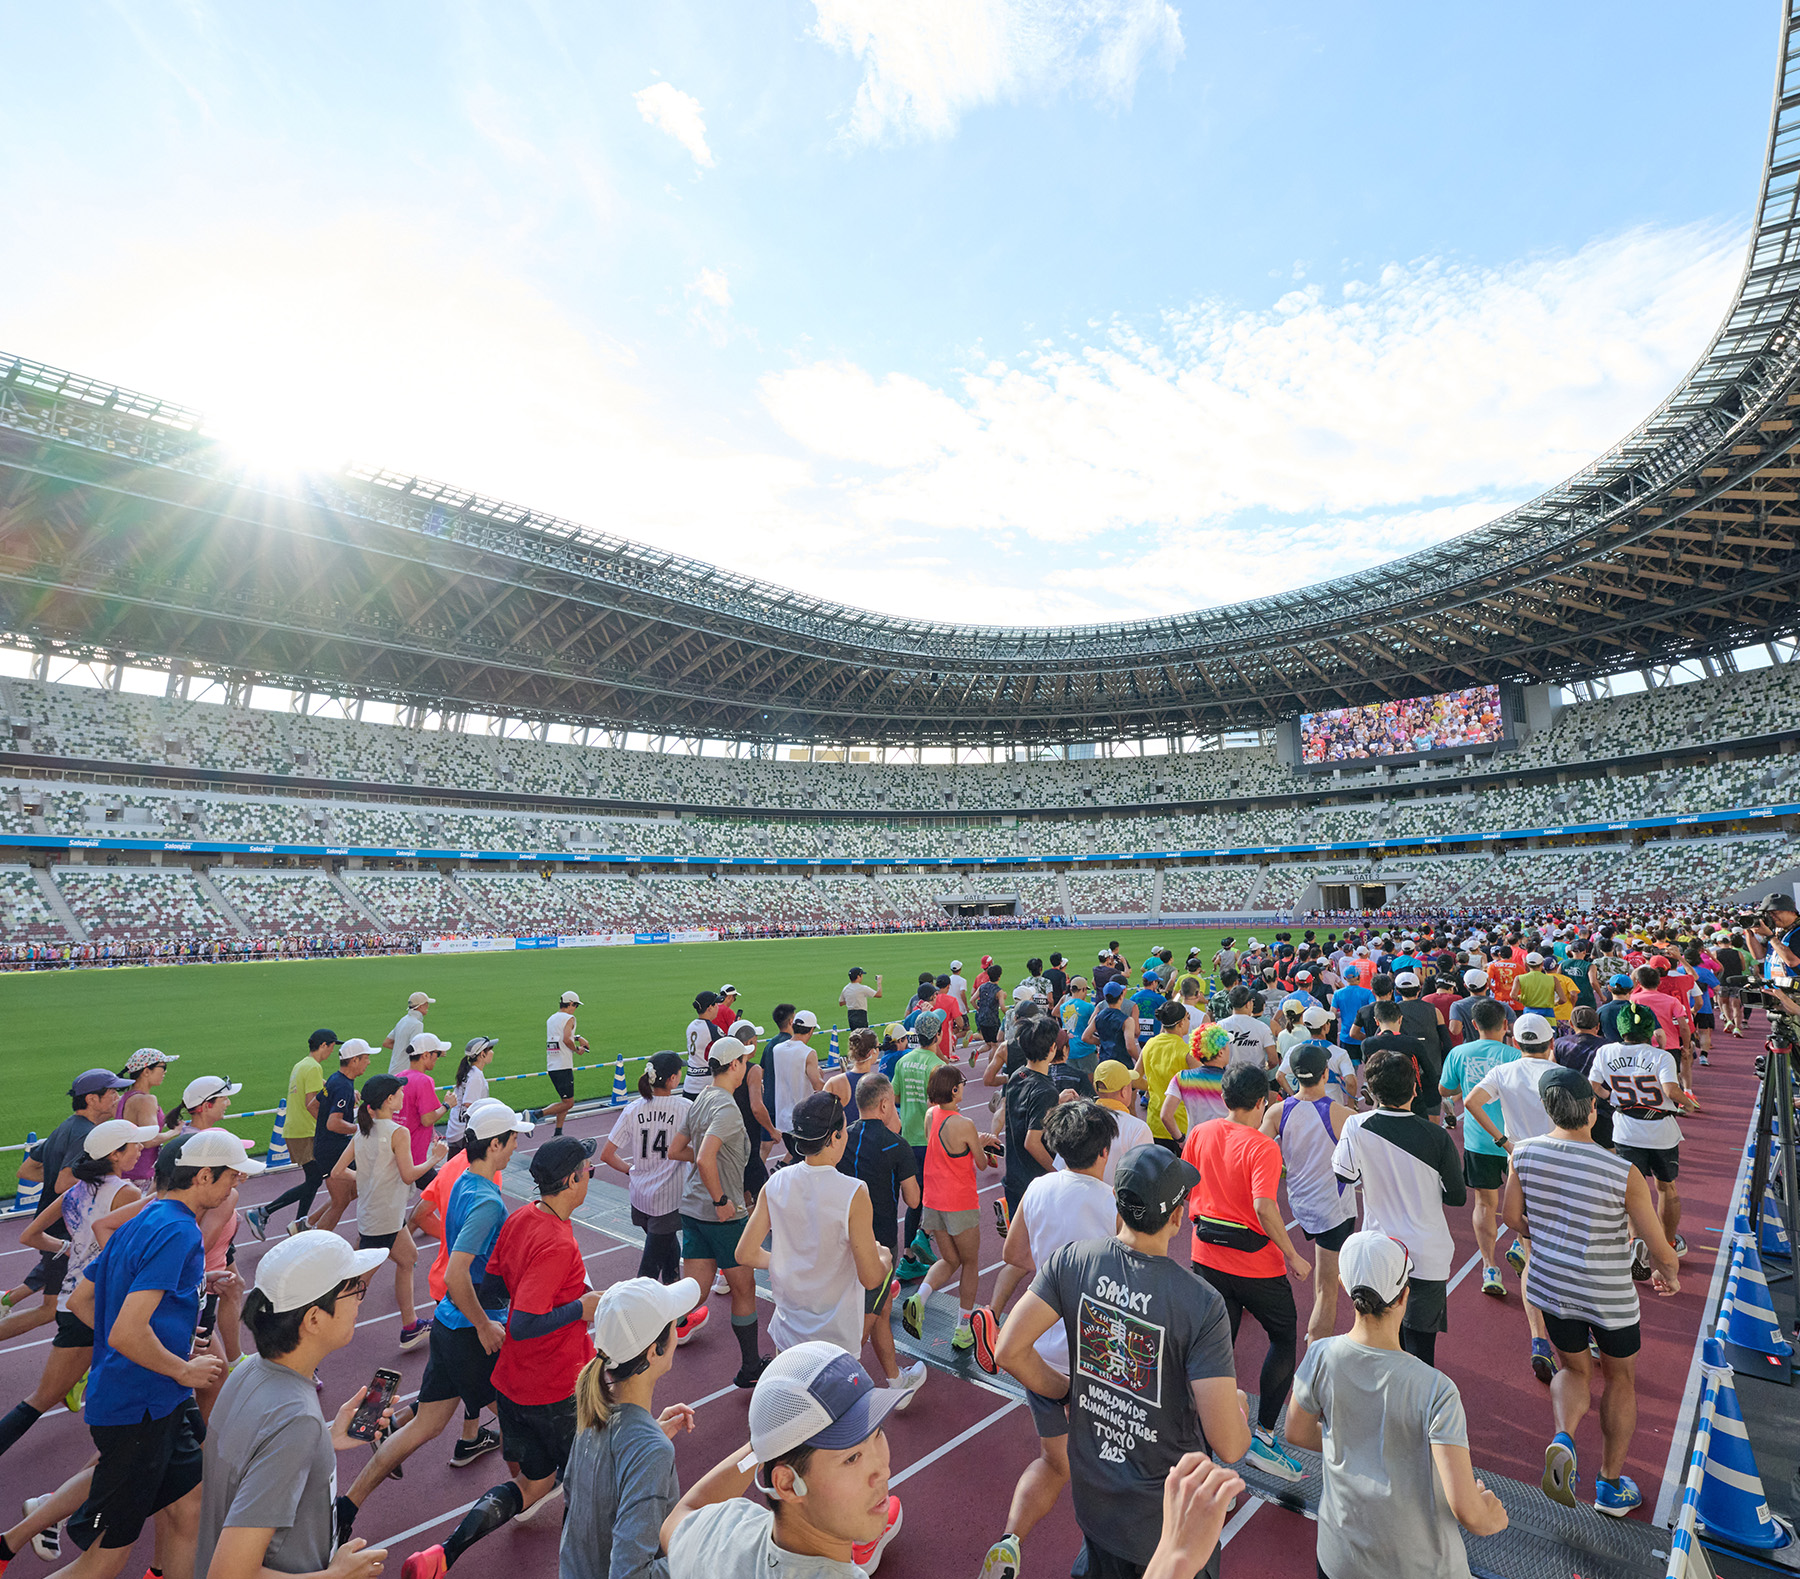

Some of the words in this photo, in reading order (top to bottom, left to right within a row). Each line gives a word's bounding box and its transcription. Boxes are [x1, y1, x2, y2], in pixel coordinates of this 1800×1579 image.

[1677, 815, 1699, 824] Salonpas
[1749, 808, 1773, 817] Salonpas
[1608, 822, 1629, 830] Salonpas
[69, 839, 100, 848] Salonpas
[164, 842, 192, 851] Salonpas
[249, 845, 275, 854] Salonpas
[326, 848, 349, 856] Salonpas
[396, 849, 417, 857] Salonpas
[690, 1031, 698, 1056] 8
[1607, 1056, 1654, 1072] GODZILLA
[1610, 1075, 1664, 1107] 55
[638, 1111, 675, 1126] OJIMA
[641, 1128, 669, 1159] 14
[1096, 1275, 1152, 1315] SAYSKY
[1107, 1319, 1130, 1382] 東京
[1093, 1421, 1136, 1450] TOKYO
[1098, 1440, 1127, 1463] 2025
